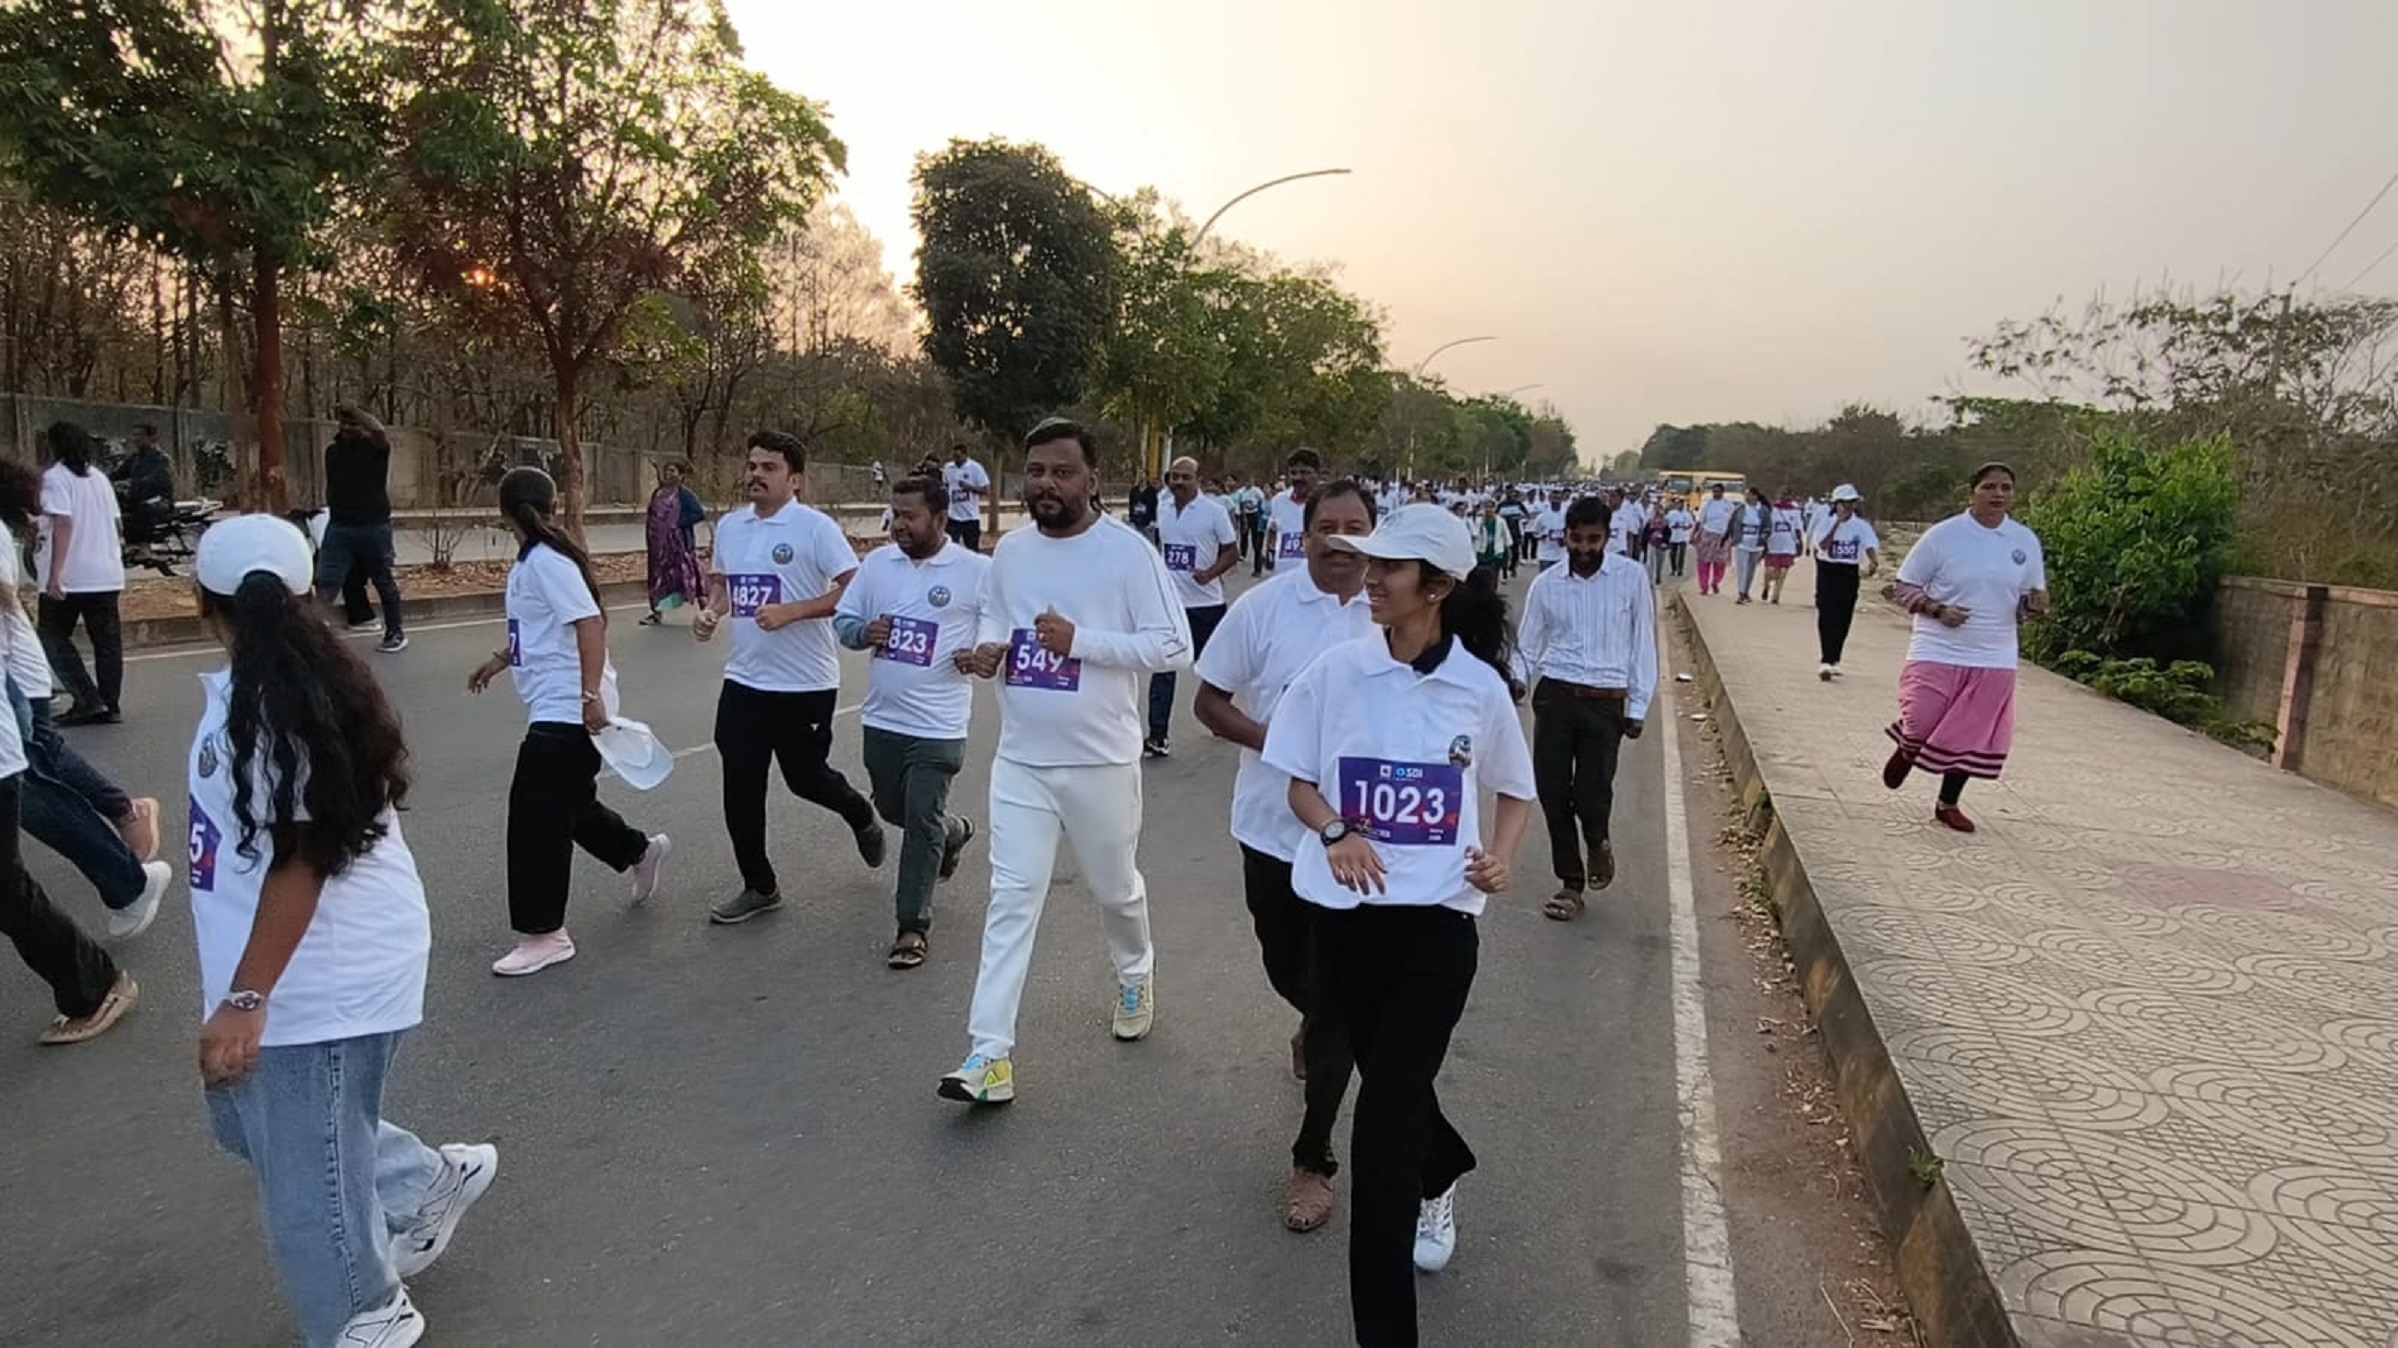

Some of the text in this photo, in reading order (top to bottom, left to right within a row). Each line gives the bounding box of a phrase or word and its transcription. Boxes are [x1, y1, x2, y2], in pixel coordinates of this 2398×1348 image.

[1168, 551, 1189, 565] 278
[889, 628, 927, 653] 823
[1016, 644, 1064, 673] 549
[1355, 780, 1445, 825] 1023
